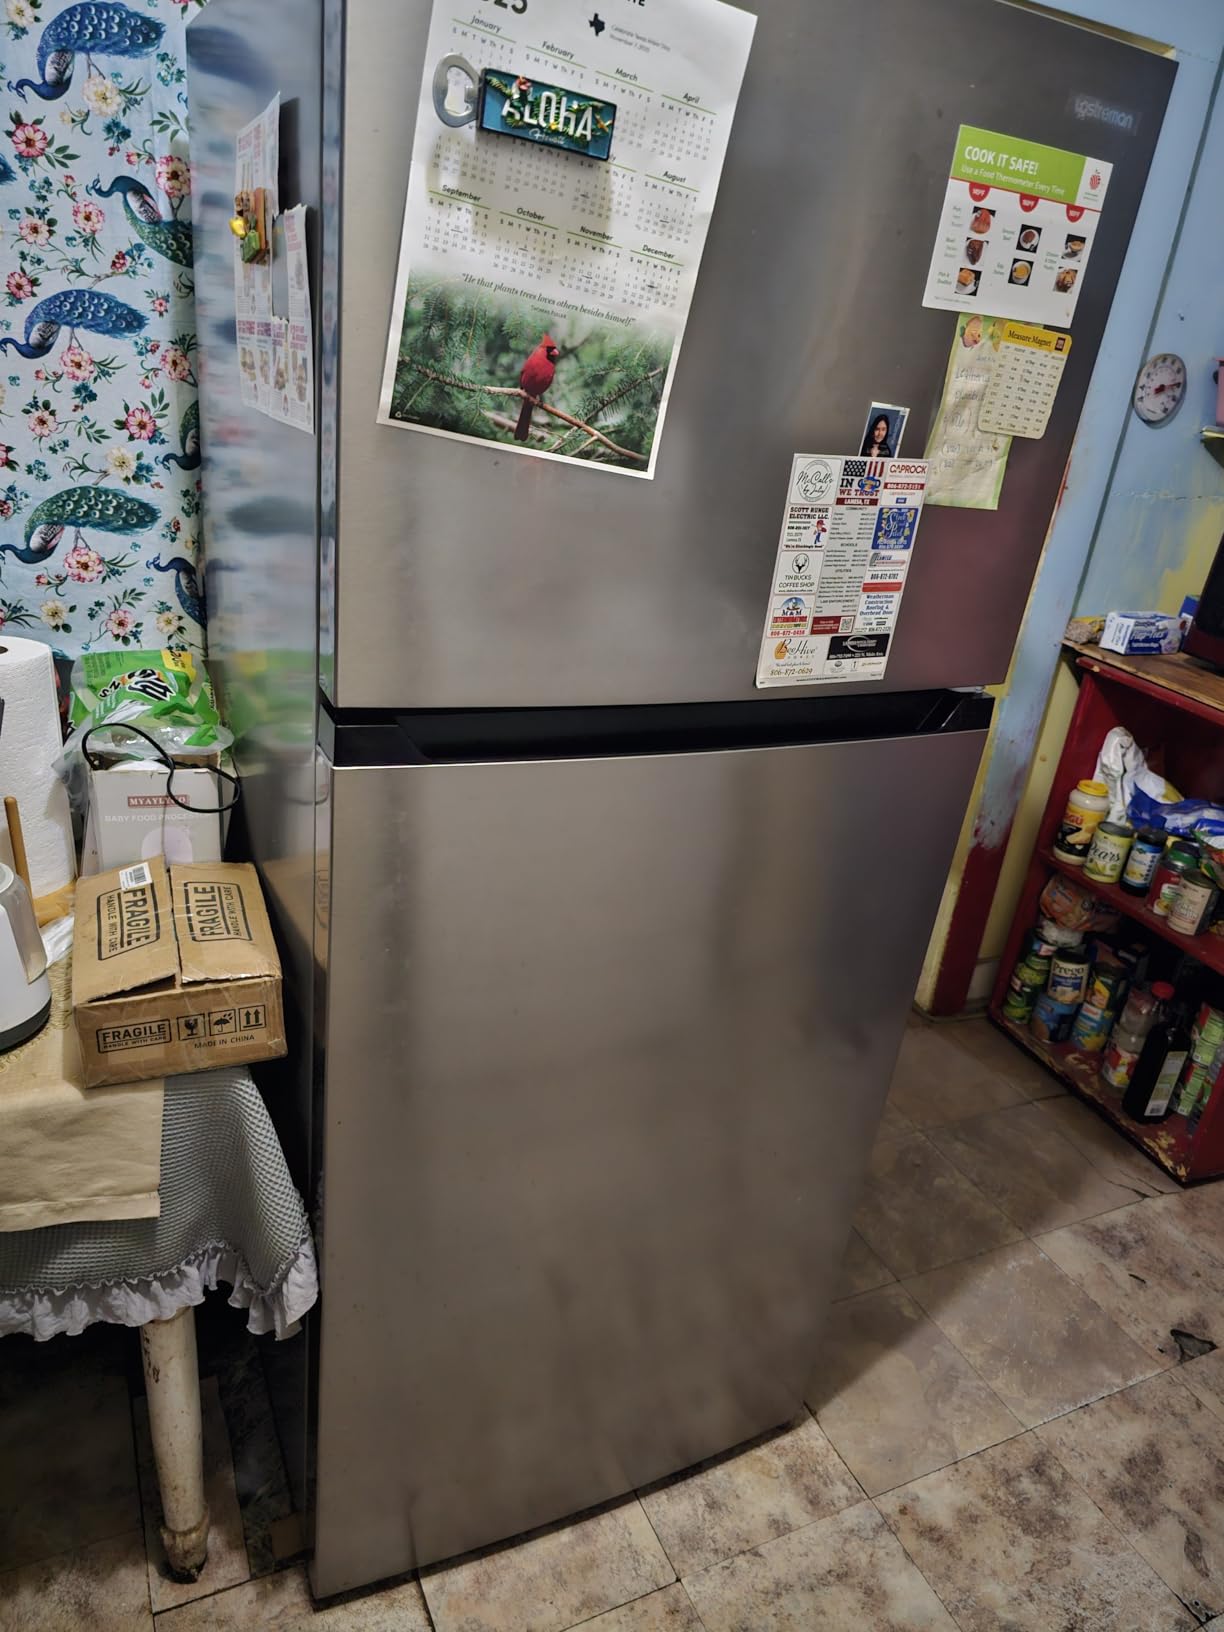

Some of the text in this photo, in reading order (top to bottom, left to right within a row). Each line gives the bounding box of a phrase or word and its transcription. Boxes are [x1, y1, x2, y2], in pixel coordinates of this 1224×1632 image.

[471, 15, 502, 33] January
[542, 41, 575, 60] February
[615, 67, 638, 82] March
[683, 92, 700, 104] April
[964, 146, 1040, 176] COOK IT SAFE!
[663, 171, 687, 184] August
[961, 165, 974, 176] Use
[980, 168, 996, 180] Food
[996, 172, 1034, 190] Thermometer
[1034, 180, 1050, 196] Every
[1051, 184, 1065, 196] Time
[442, 184, 482, 202] September
[516, 207, 546, 222] October
[580, 225, 614, 241] November
[642, 244, 675, 260] December
[476, 276, 493, 290] that
[494, 280, 519, 298] plants
[520, 287, 537, 300] trees
[538, 292, 556, 305] loves
[556, 296, 579, 311] others
[580, 302, 604, 318] besides
[1008, 330, 1052, 348] Measure Magnet
[888, 464, 927, 474] CAPROCK
[840, 478, 853, 487] IN
[132, 814, 157, 822] FOOD
[124, 888, 150, 946] FRAGILE
[194, 886, 224, 937] FRAGILE
[223, 886, 241, 937] HANDLE WITH CARE
[106, 894, 118, 953] HANDLE WITH CARE
[102, 1023, 167, 1042] FRAGILE
[194, 1040, 215, 1049] MADE
[230, 1034, 255, 1044] CHINA
[103, 1040, 130, 1050] HANDLE
[150, 1034, 168, 1043] CARE
